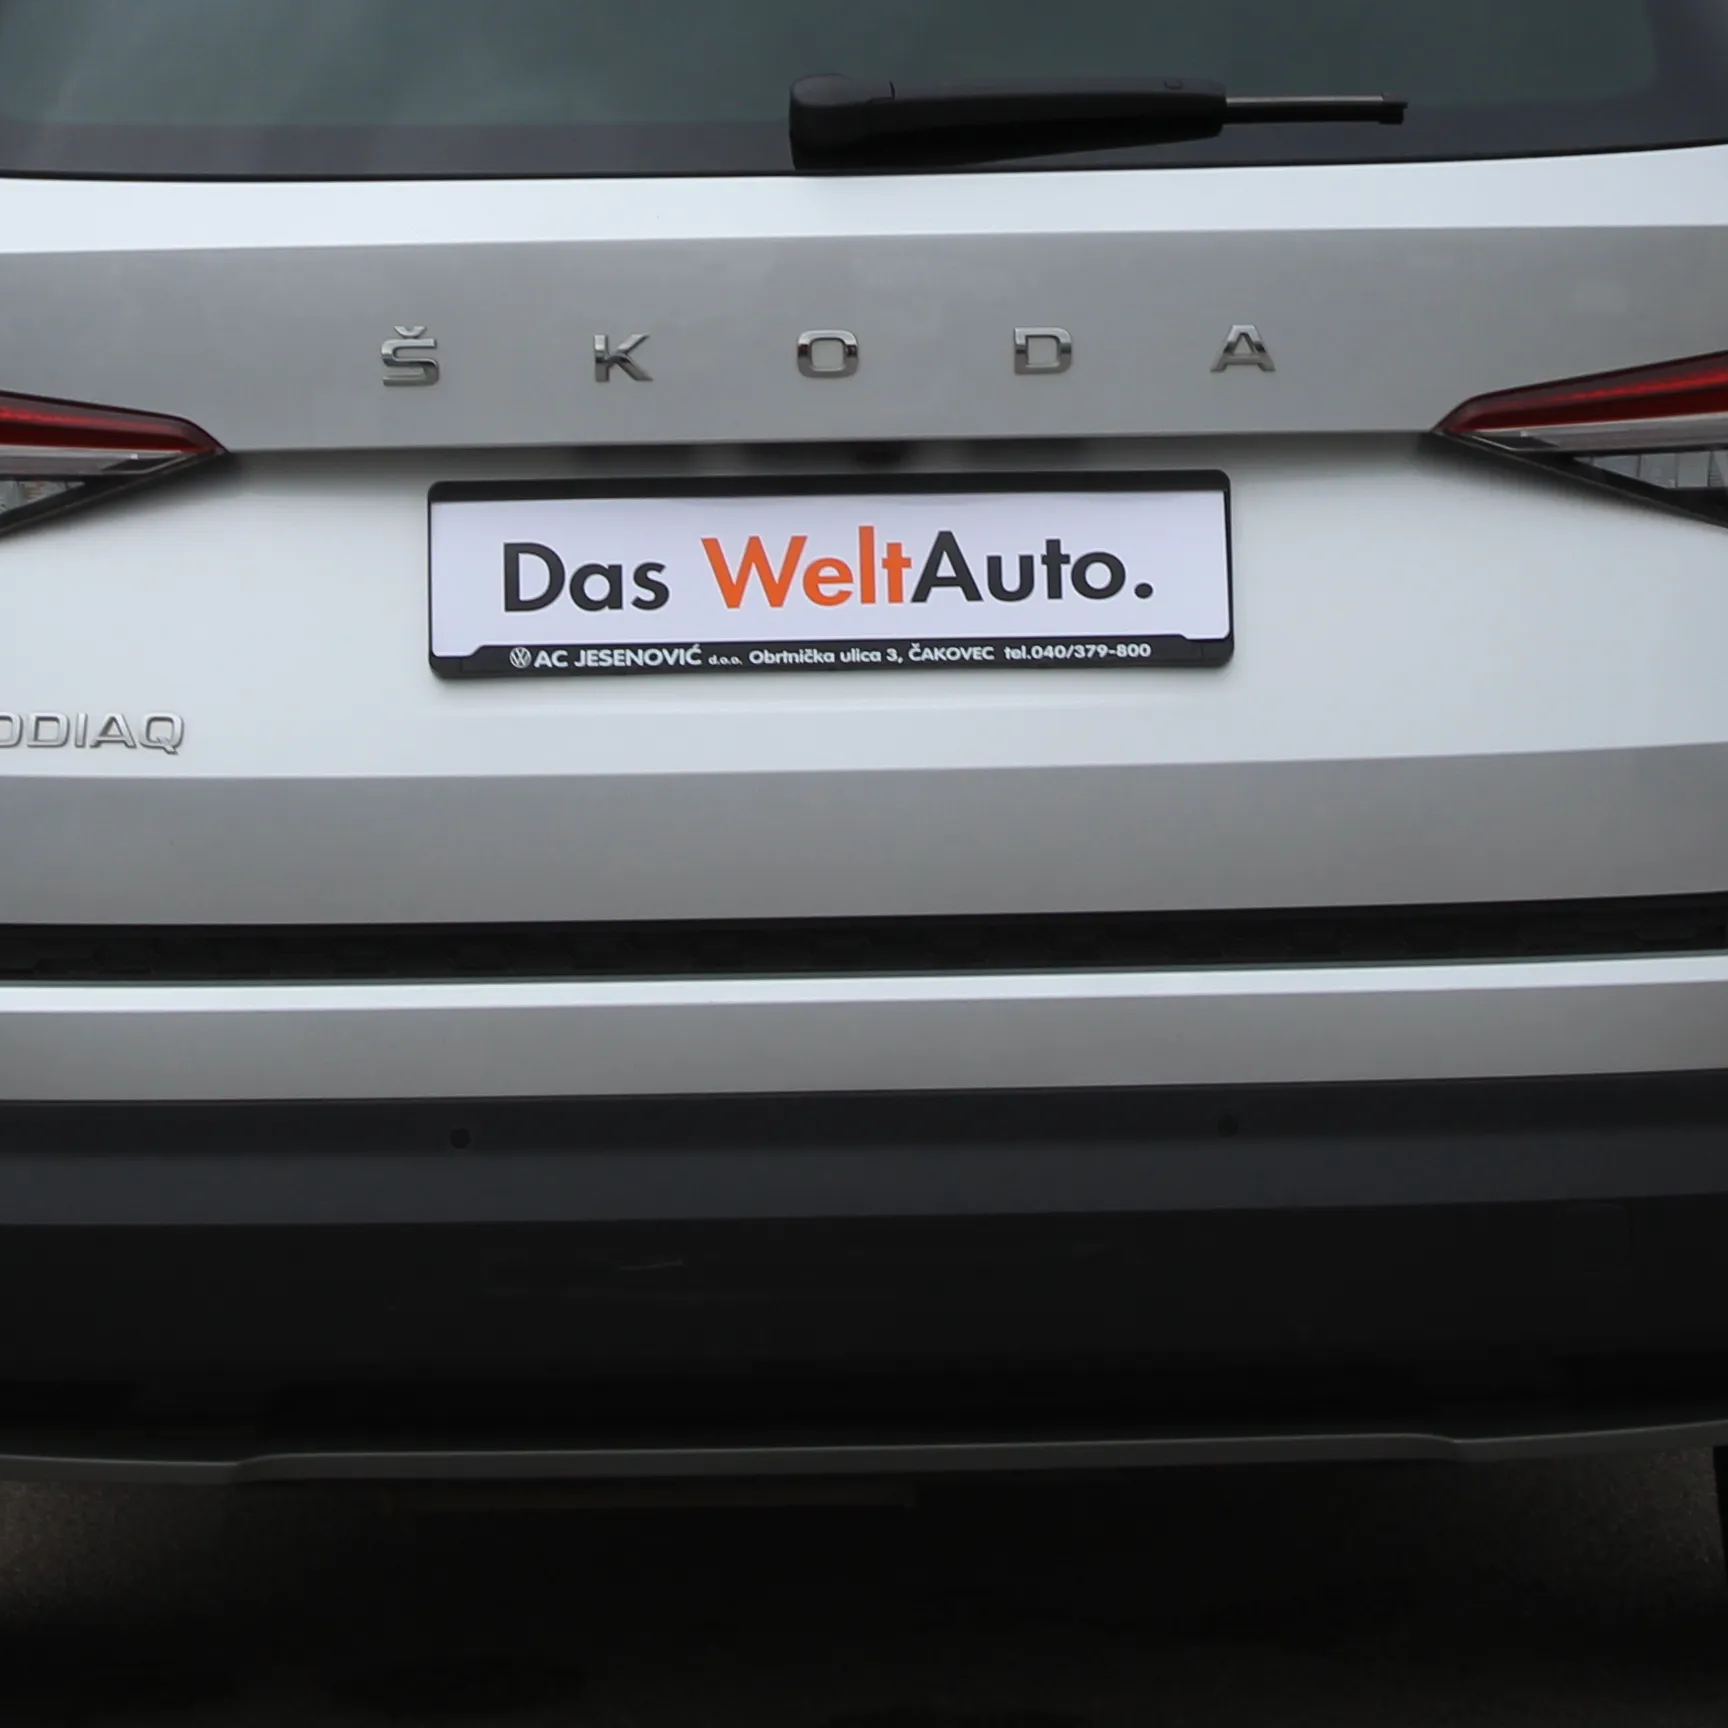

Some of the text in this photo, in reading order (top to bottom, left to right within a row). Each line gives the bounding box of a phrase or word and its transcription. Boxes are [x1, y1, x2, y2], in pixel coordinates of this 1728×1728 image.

[379, 324, 1276, 387] ŠKODA
[502, 525, 1155, 613] Das WeltAuto.
[533, 649, 569, 668] AC
[573, 643, 702, 668] JESENOVIĆ
[748, 647, 834, 665] Obrtnička
[839, 646, 882, 663] ulica
[908, 642, 995, 662] ČAKOVEC
[1003, 643, 1152, 660] tel.040/379-800
